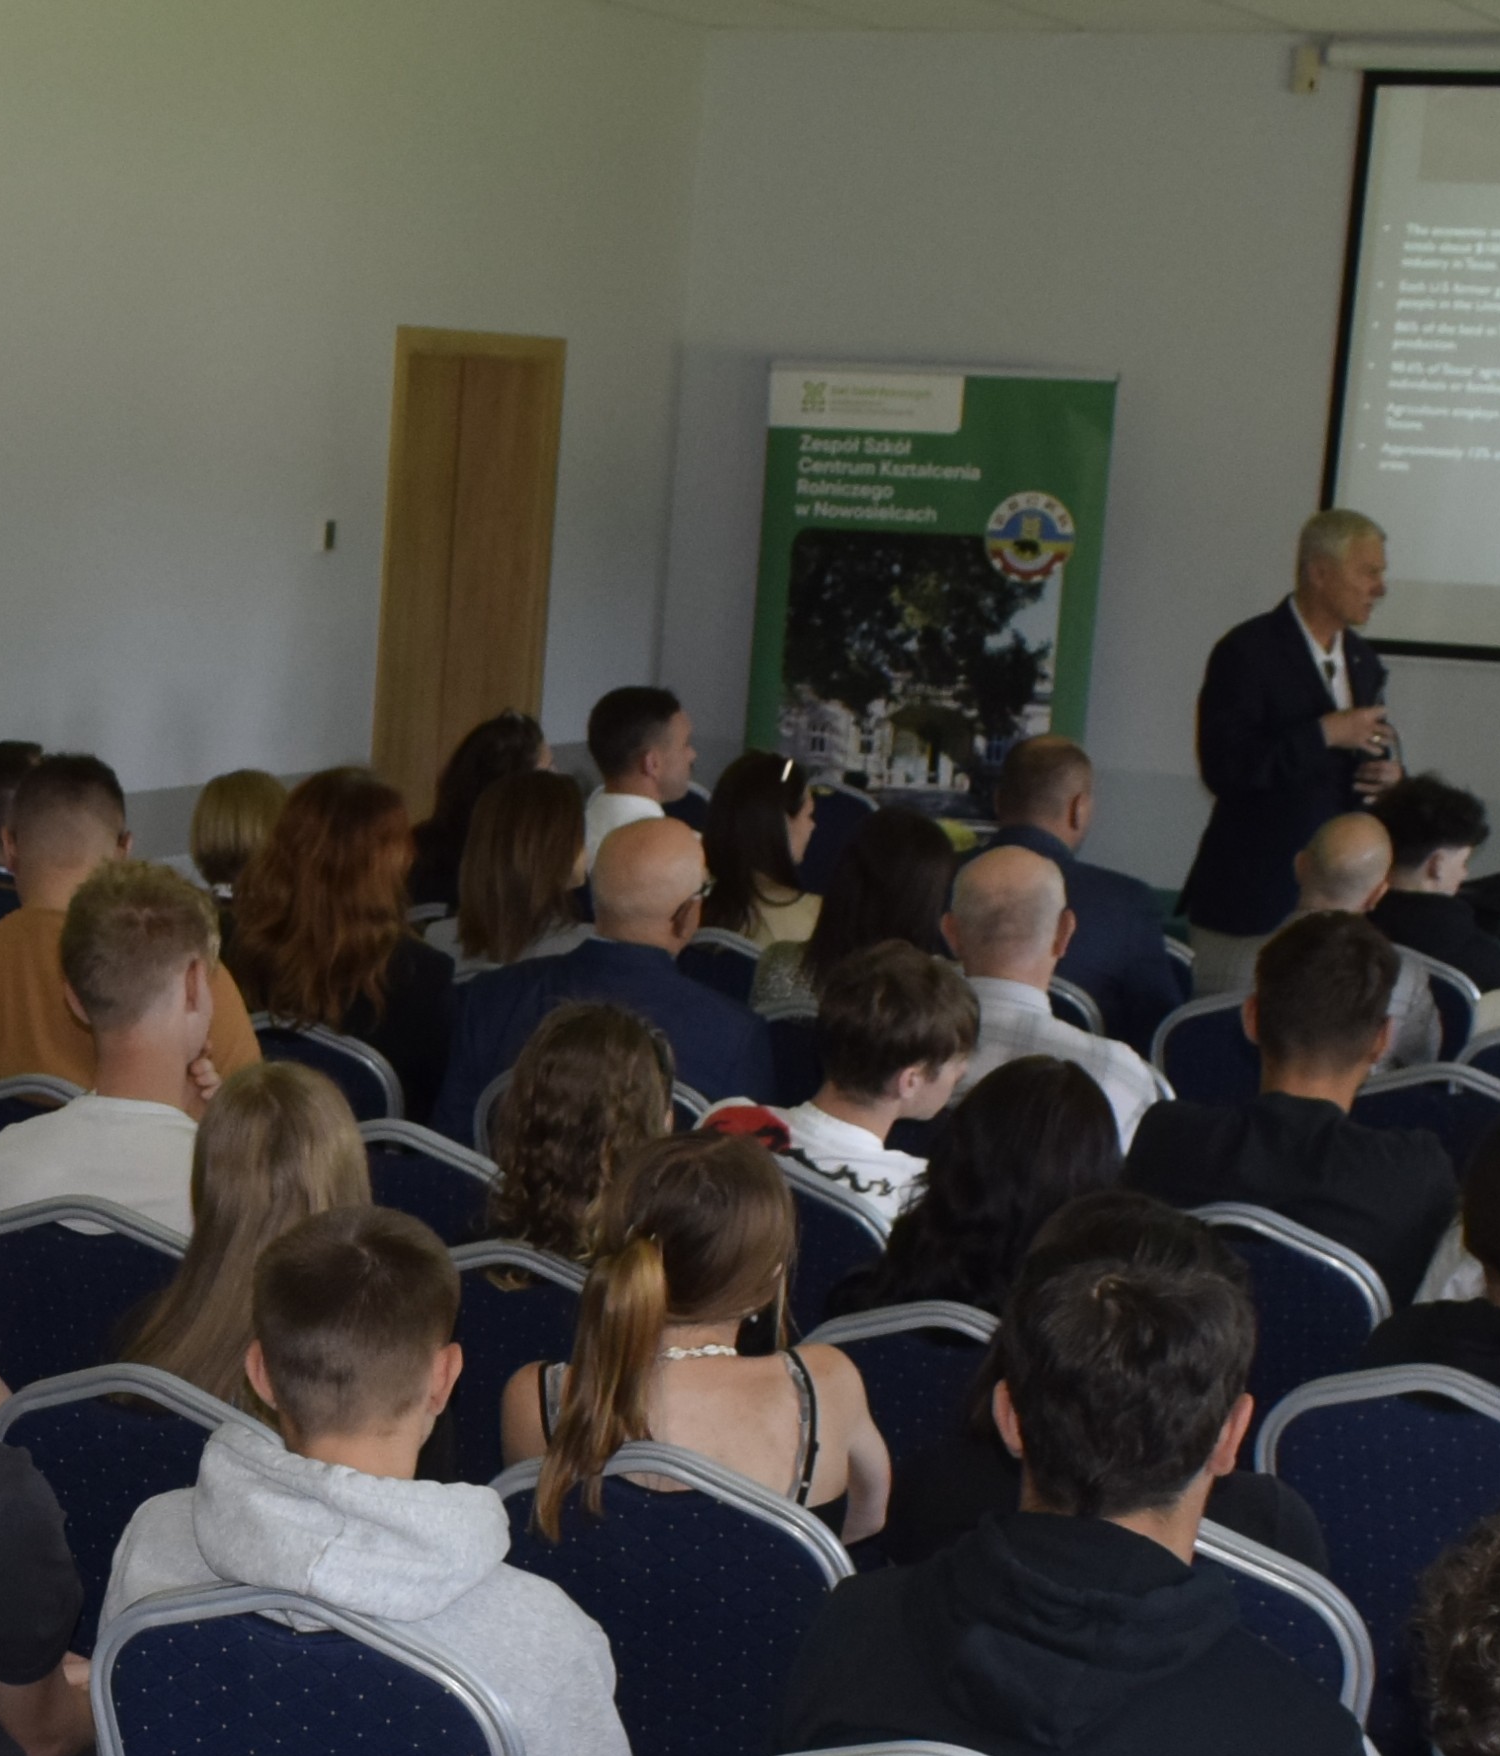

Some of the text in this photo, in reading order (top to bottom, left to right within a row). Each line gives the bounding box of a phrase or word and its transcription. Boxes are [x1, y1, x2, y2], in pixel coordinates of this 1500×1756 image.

[799, 434, 912, 456] Zespół Szkół
[797, 456, 982, 481] Centrum Kształcenia
[796, 478, 895, 502] Rolniczego
[794, 501, 938, 523] w Nowosielcach
